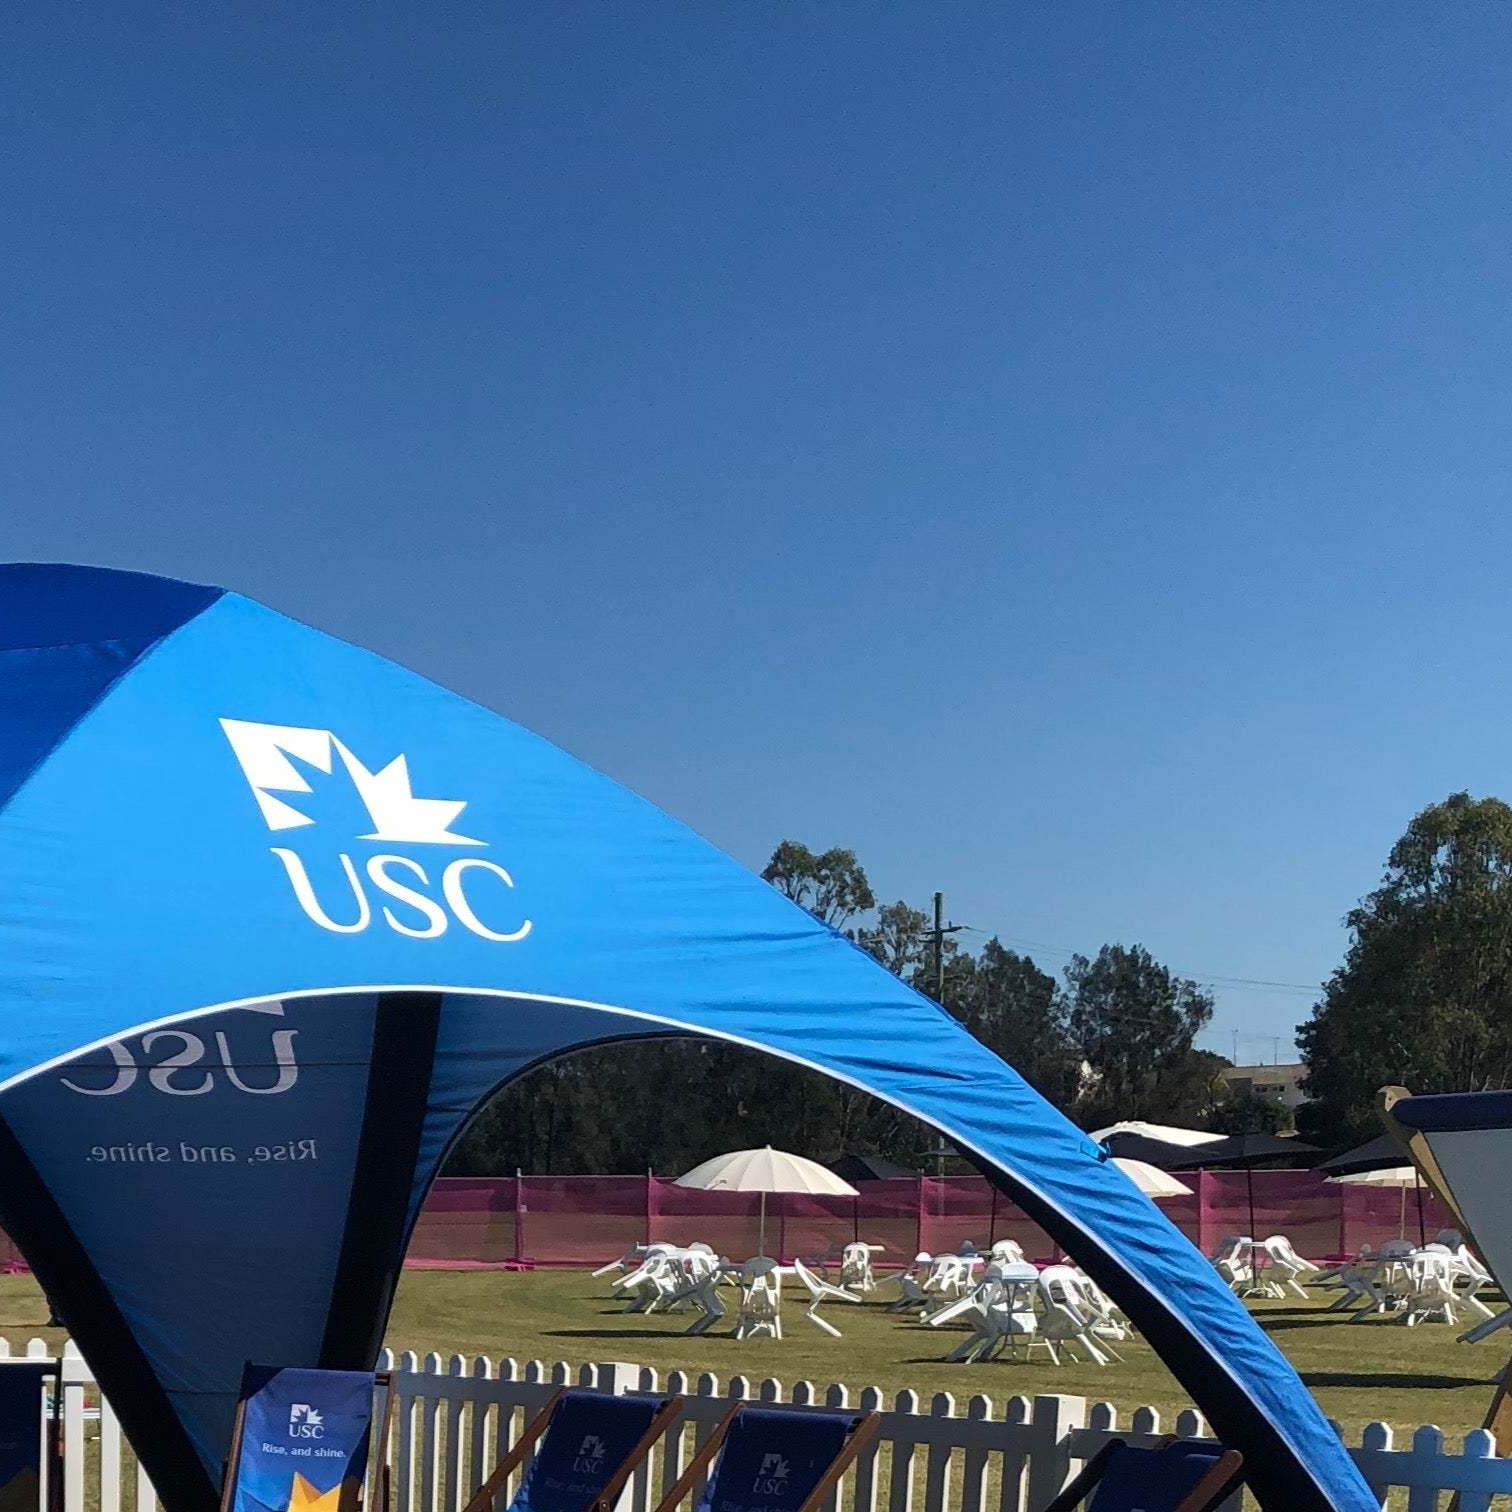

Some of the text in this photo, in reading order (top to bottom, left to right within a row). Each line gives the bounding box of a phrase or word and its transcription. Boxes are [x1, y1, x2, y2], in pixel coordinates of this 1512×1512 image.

[270, 847, 532, 941] USC
[289, 1424, 324, 1439] USC
[262, 1443, 347, 1459] Rise, and shine.
[573, 1457, 603, 1474] USC
[753, 1477, 788, 1496] USC
